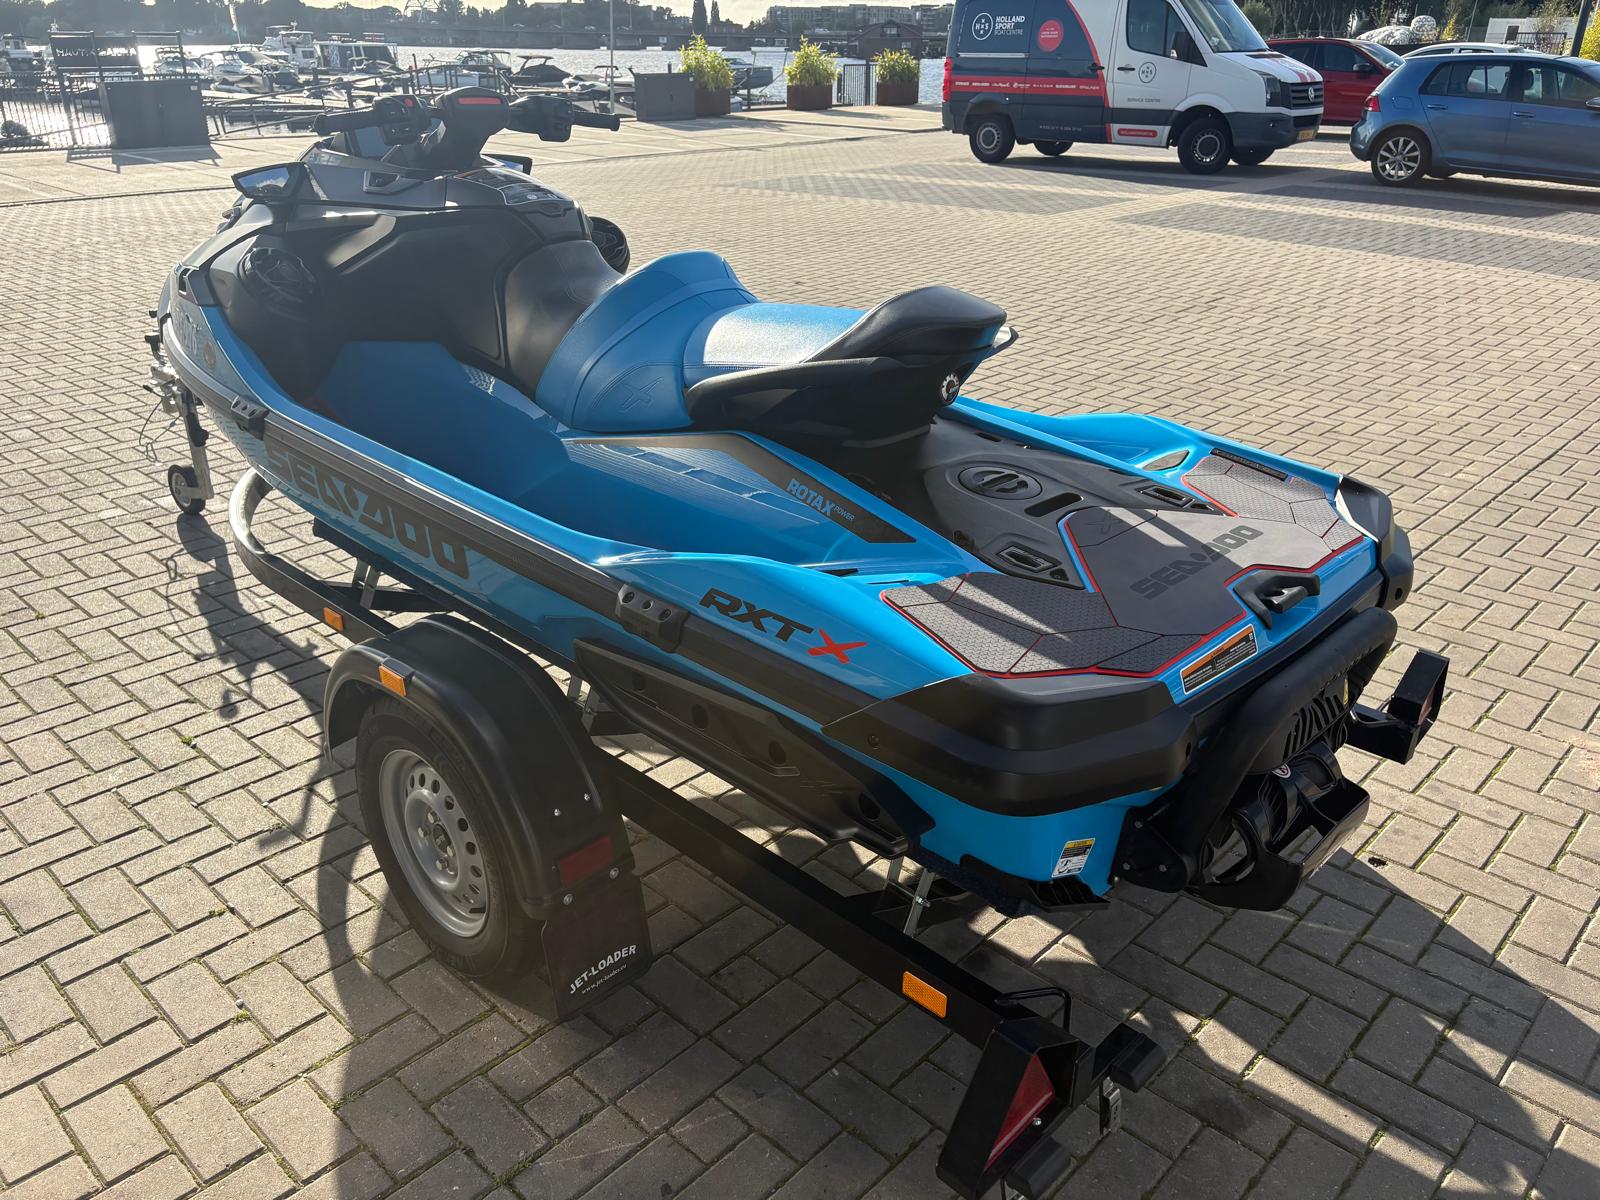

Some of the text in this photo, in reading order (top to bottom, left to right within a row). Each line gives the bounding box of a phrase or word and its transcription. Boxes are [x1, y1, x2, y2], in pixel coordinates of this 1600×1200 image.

[995, 15, 1026, 23] HOLLAND
[995, 22, 1015, 30] SPORT
[786, 478, 855, 521] ROTAX POWER
[699, 587, 814, 642] RXT
[569, 944, 637, 994] JET-LOADER
